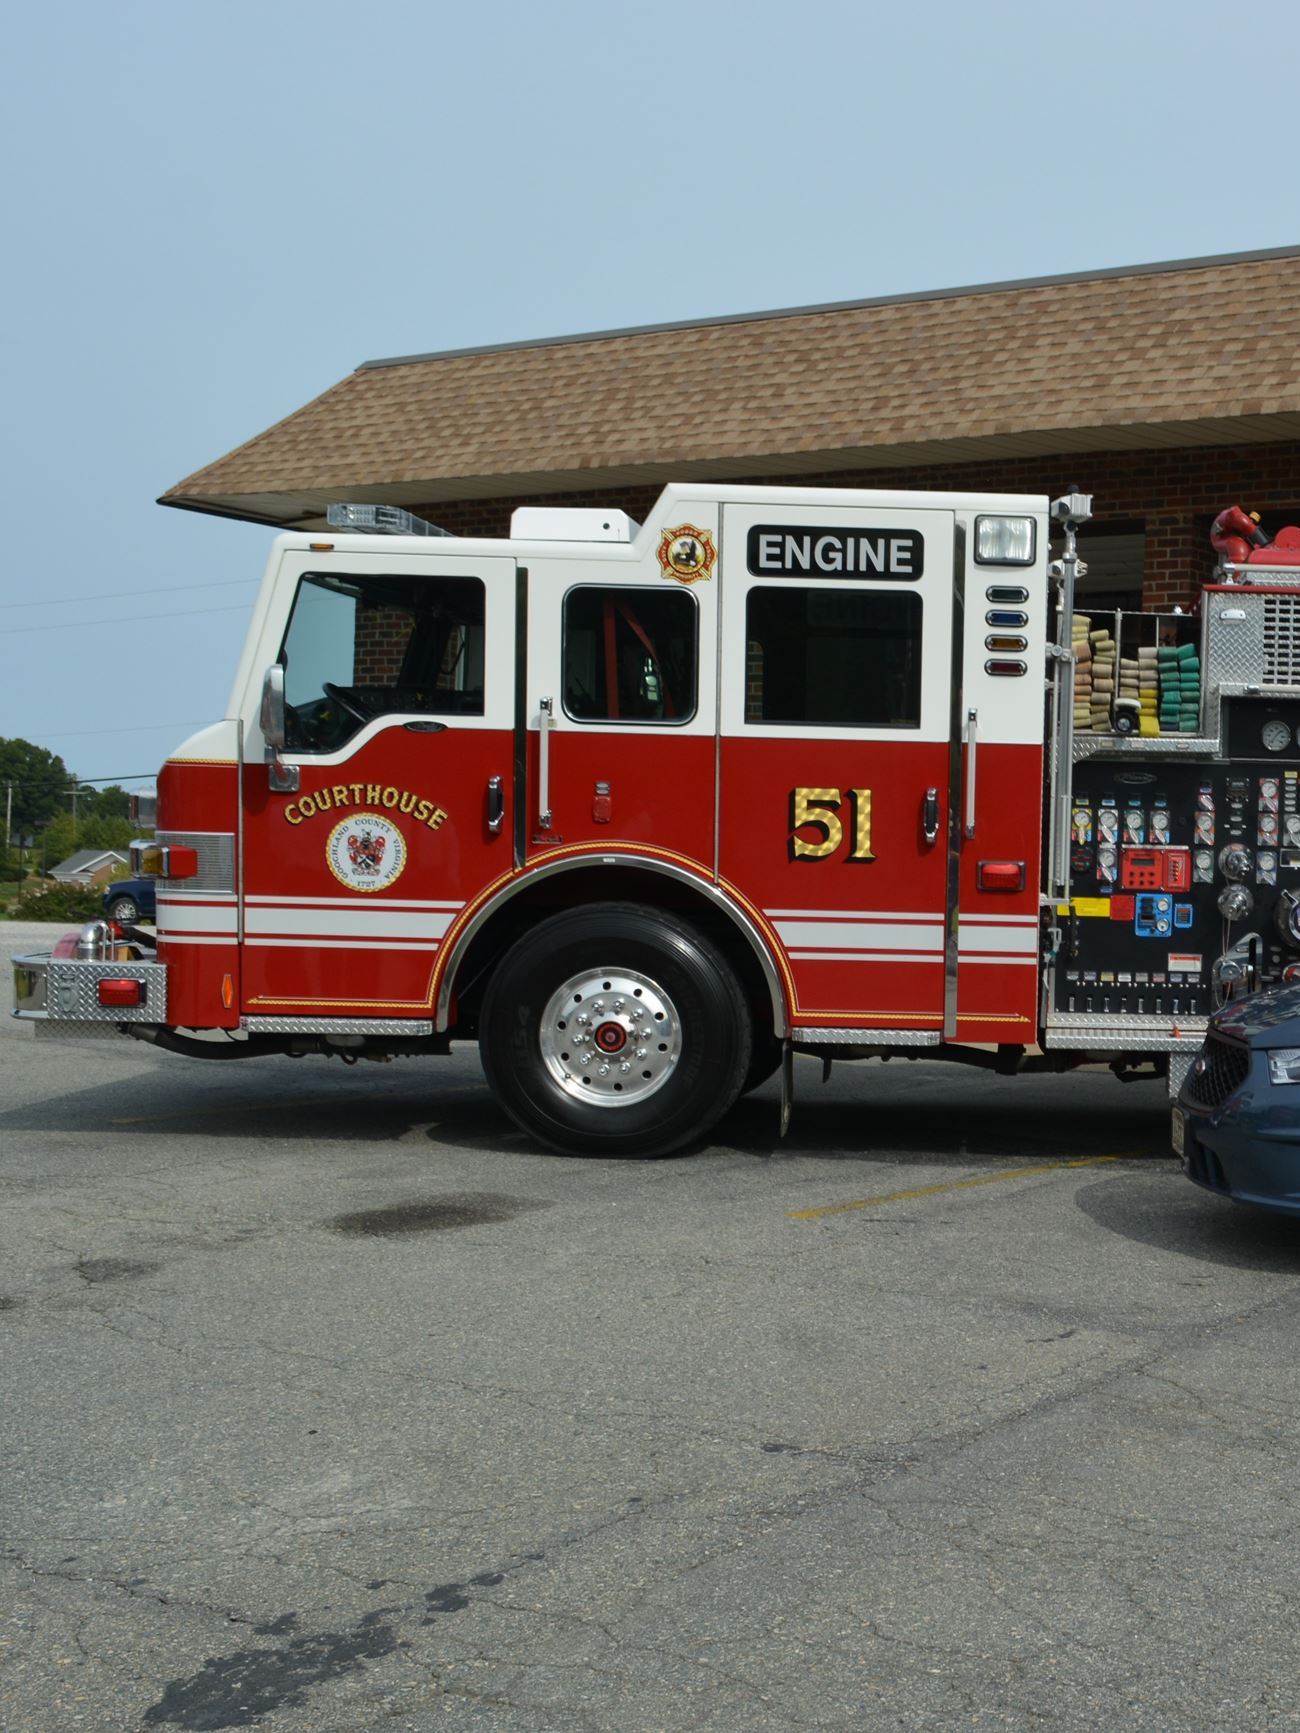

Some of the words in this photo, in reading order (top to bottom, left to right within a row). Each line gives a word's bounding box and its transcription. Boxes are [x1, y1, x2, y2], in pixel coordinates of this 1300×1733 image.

[758, 534, 914, 574] ENGINE
[283, 784, 449, 831] COURTHOUSE
[788, 787, 877, 863] 51
[331, 825, 350, 879] GOOCHLAND
[354, 818, 392, 834] COUNTY
[384, 838, 402, 880] VIRGINIA
